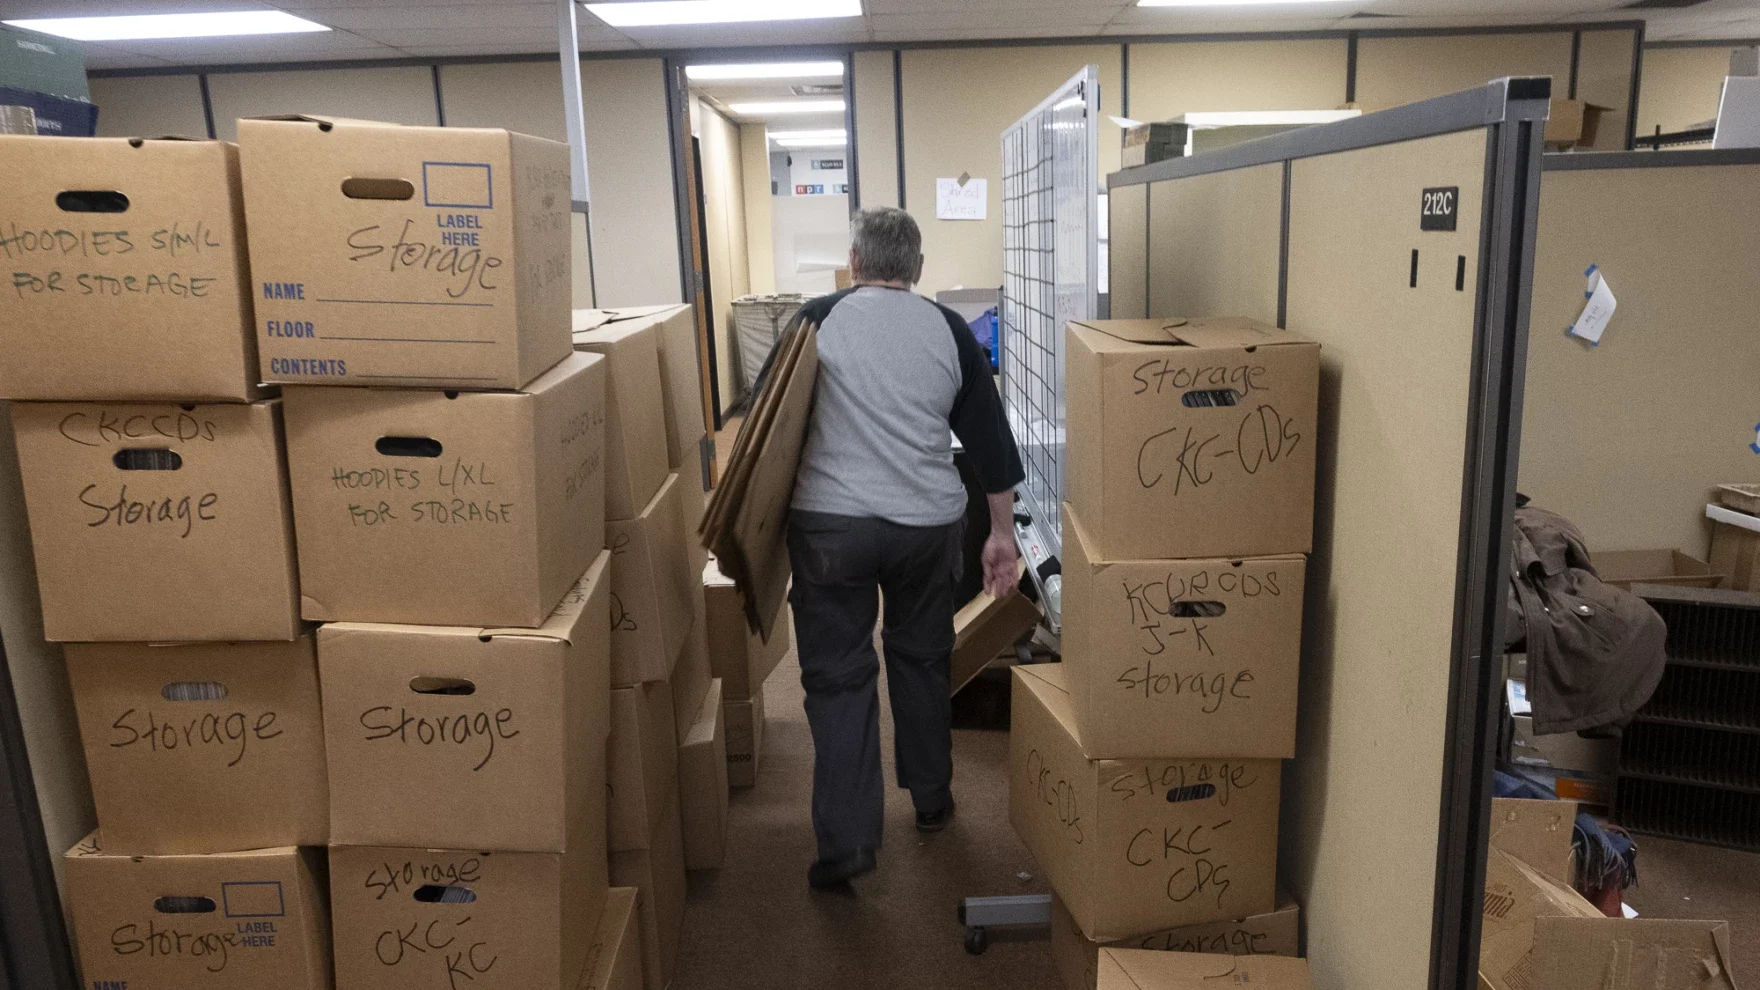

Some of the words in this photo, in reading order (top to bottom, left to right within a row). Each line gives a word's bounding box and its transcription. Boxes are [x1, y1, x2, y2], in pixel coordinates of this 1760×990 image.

[796, 185, 823, 194] npr
[1423, 191, 1453, 215] 212C
[437, 213, 483, 229] LABEL
[0, 222, 134, 259] HOODIES
[151, 221, 220, 257] S/M/L
[441, 231, 480, 247] HERE
[346, 218, 502, 299] Storage
[13, 271, 64, 299] FOR
[77, 271, 217, 297] STORAGE
[263, 282, 305, 300] NAME
[266, 320, 315, 338] FLOOR
[270, 357, 347, 377] CONTENTS
[1133, 358, 1269, 398] Storage
[331, 465, 421, 491] HOODIES
[437, 456, 496, 494] L/XL
[78, 483, 218, 539] Storage
[348, 500, 398, 527] FOR
[410, 498, 515, 525] STORAGE
[110, 708, 284, 767] Storage
[359, 705, 520, 772] Storage
[727, 753, 752, 763] 2500
[236, 921, 278, 934] LABEL
[241, 935, 276, 947] HERE
[445, 941, 498, 990] KC
[92, 981, 129, 990] NAME
